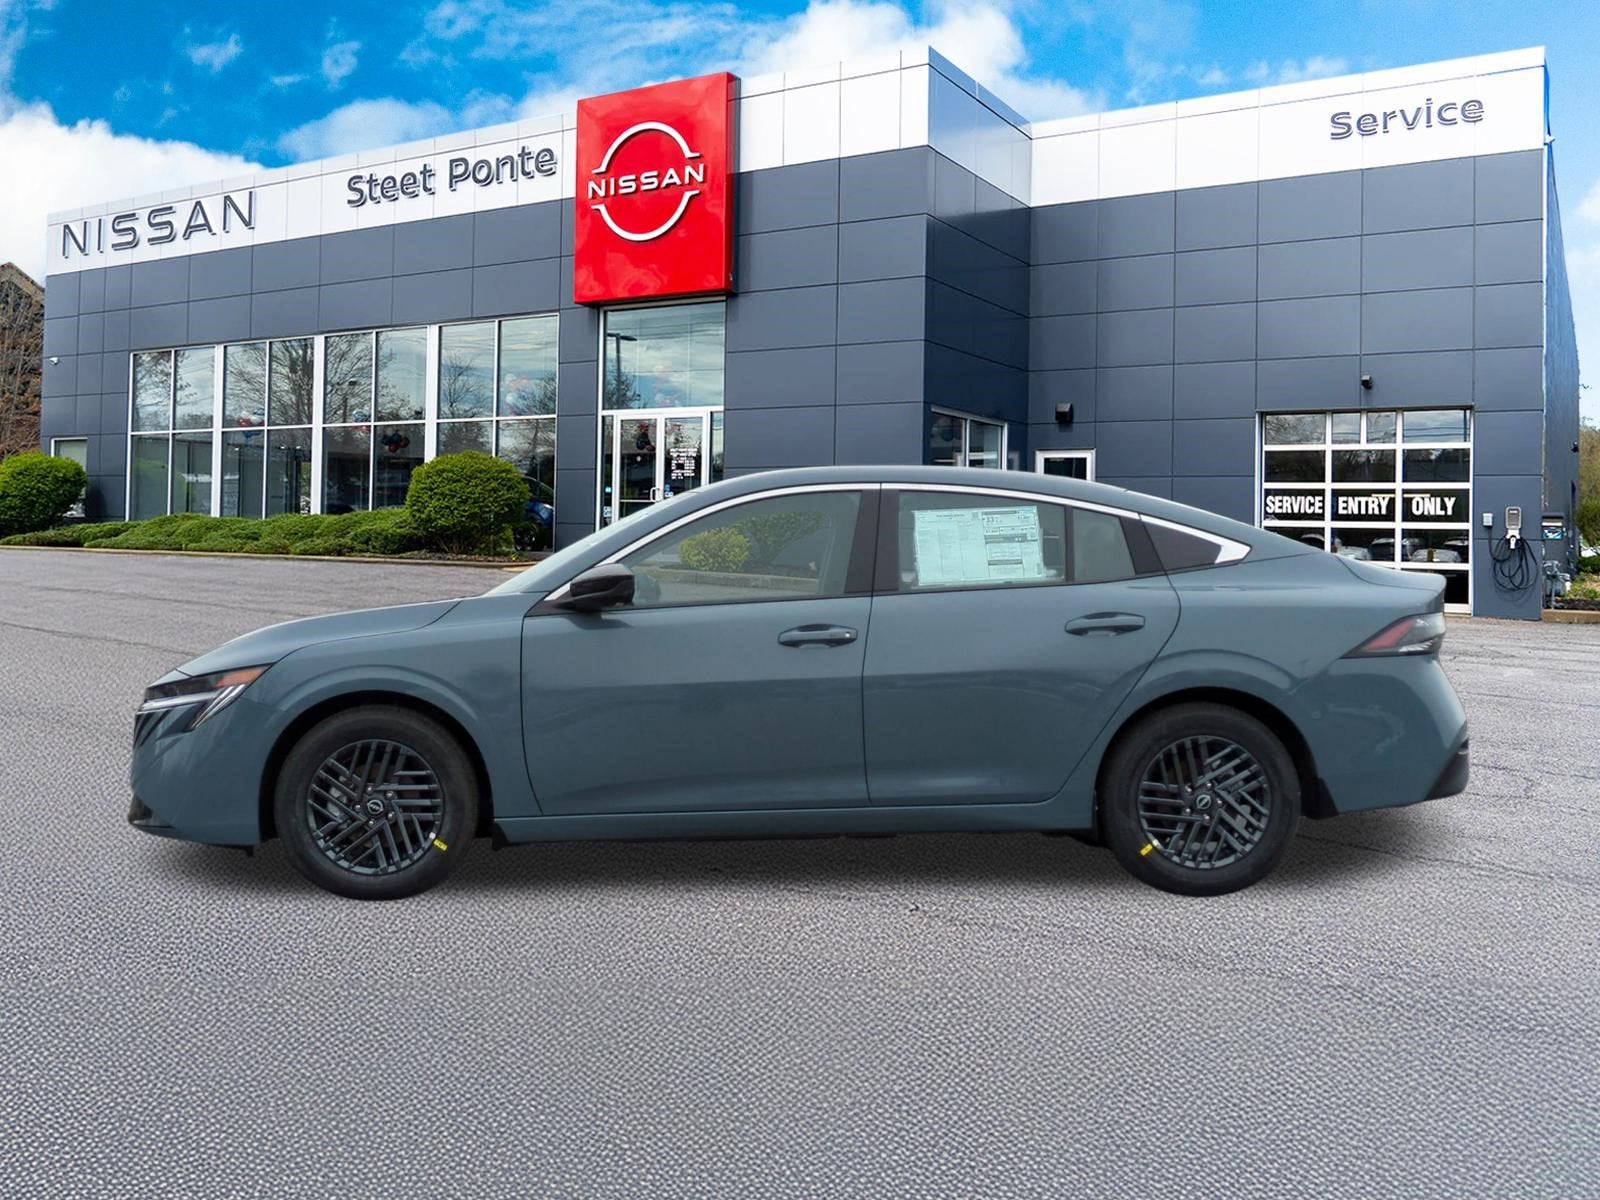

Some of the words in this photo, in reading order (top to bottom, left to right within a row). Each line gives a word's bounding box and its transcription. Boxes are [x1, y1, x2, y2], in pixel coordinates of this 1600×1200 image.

[1330, 98, 1485, 140] Service
[346, 163, 436, 207] Steet
[449, 146, 557, 192] Ponte
[588, 163, 704, 200] NISSAN
[63, 190, 255, 259] NISSAN
[1266, 495, 1323, 514] SERVICE
[1338, 496, 1390, 515] ENTRY
[1411, 496, 1457, 516] ONLY
